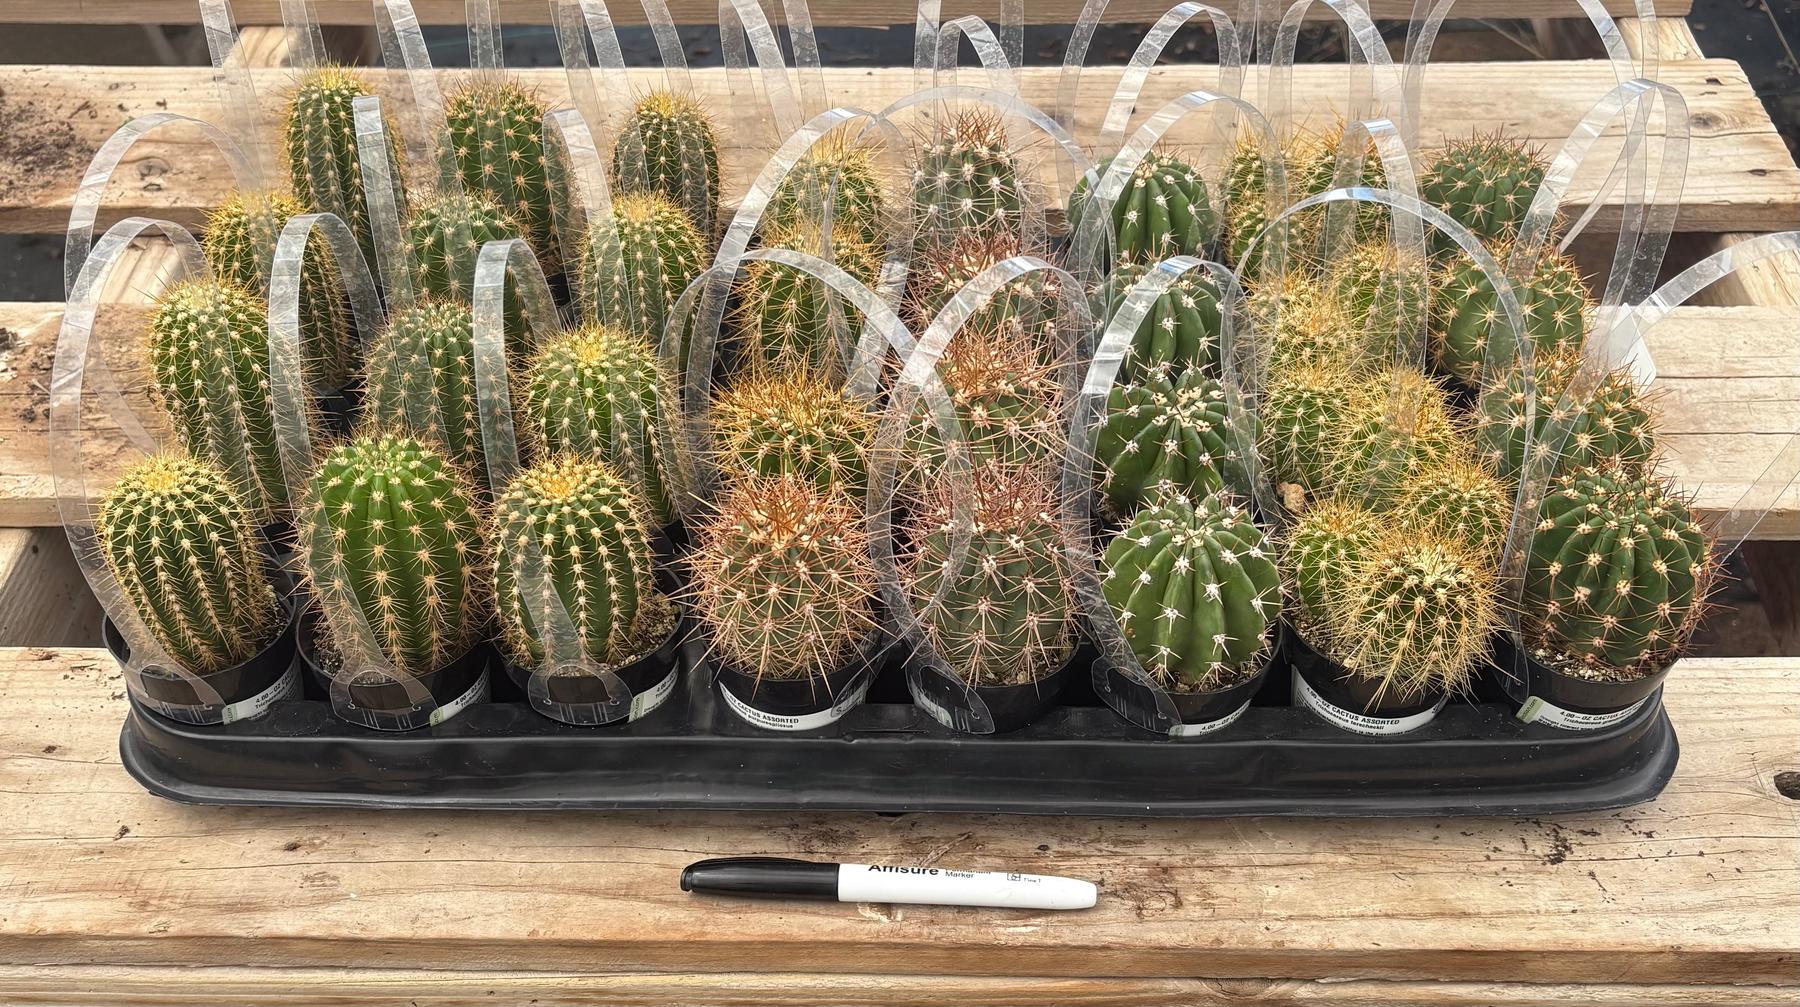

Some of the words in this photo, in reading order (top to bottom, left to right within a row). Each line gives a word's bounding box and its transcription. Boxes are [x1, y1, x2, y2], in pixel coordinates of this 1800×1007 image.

[737, 702, 761, 718] CACTUS
[762, 714, 799, 724] ASSORTED
[1331, 706, 1360, 721] CACTUS
[1361, 717, 1400, 726] ASSORTED
[944, 870, 975, 879] Marker
